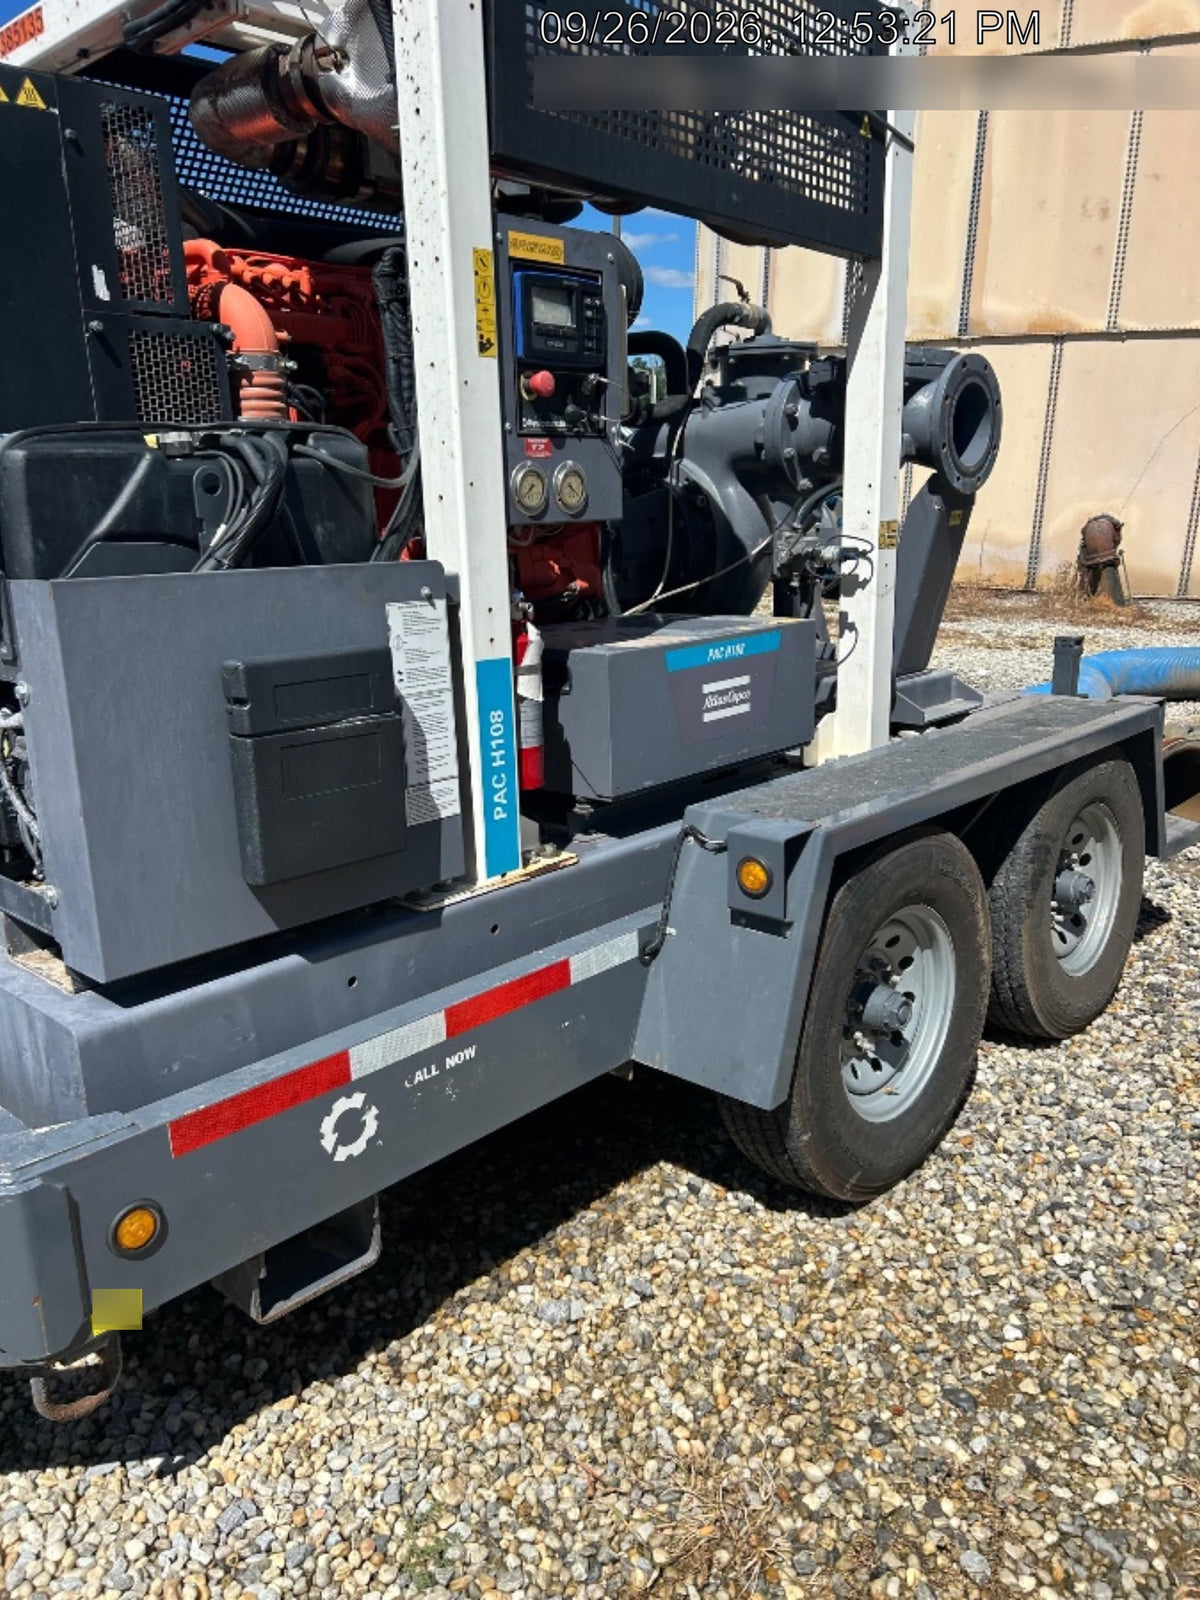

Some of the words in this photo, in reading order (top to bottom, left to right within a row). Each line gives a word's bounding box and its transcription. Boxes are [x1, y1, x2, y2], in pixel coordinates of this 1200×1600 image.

[489, 709, 506, 767] H108
[492, 773, 508, 820] PAC
[445, 1044, 477, 1070] NOW
